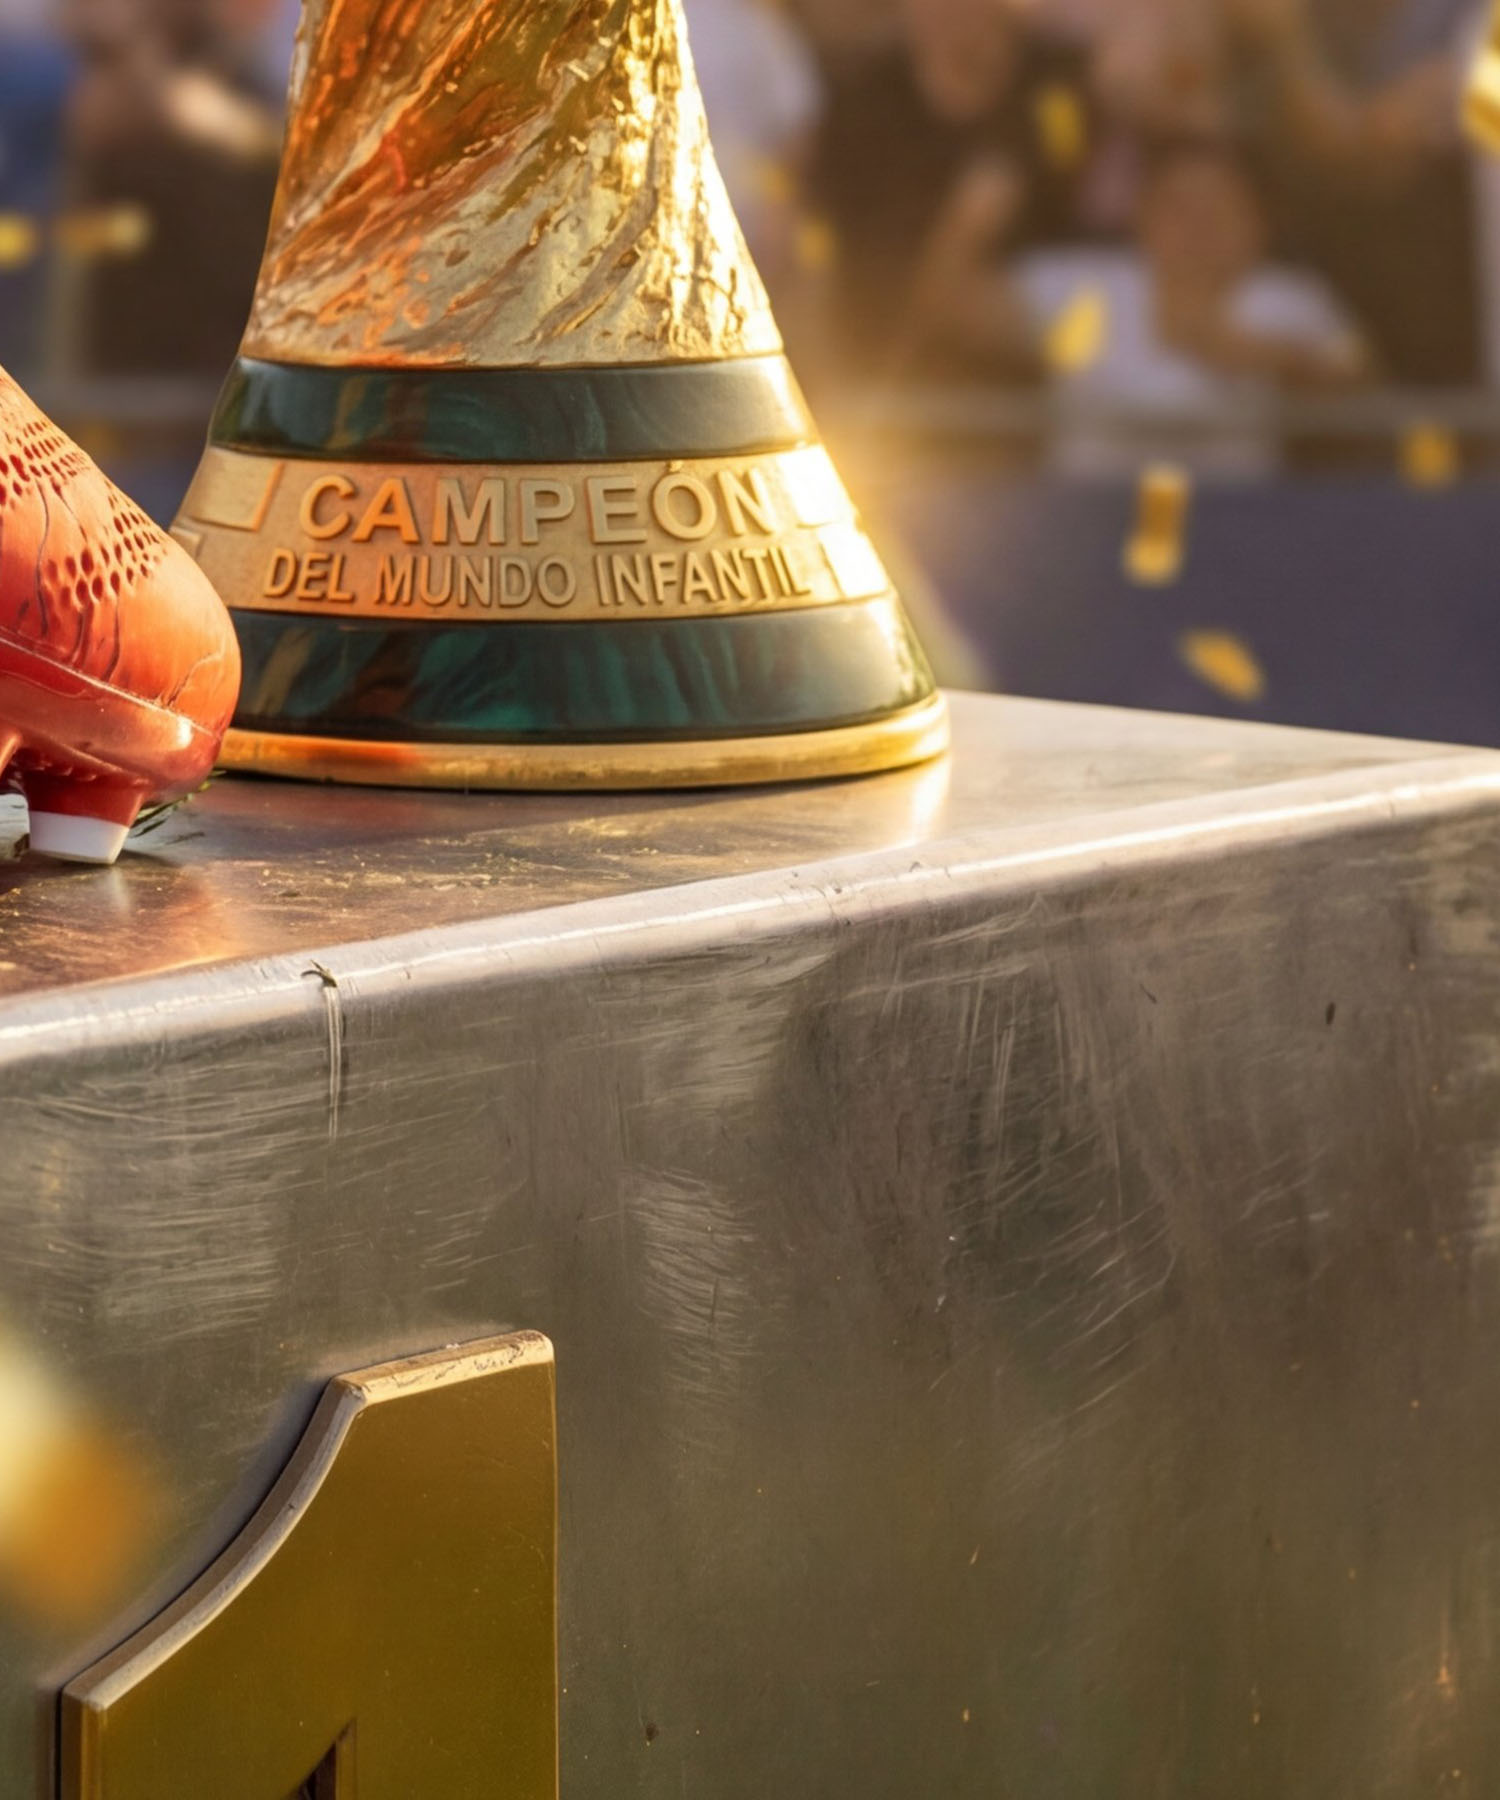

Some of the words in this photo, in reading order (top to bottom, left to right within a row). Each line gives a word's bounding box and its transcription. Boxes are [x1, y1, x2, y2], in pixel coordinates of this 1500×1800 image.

[301, 459, 777, 545] CAMPEÓN
[264, 547, 354, 603] DEL
[374, 553, 576, 608] MUNDO
[595, 542, 812, 606] INFANTIL
